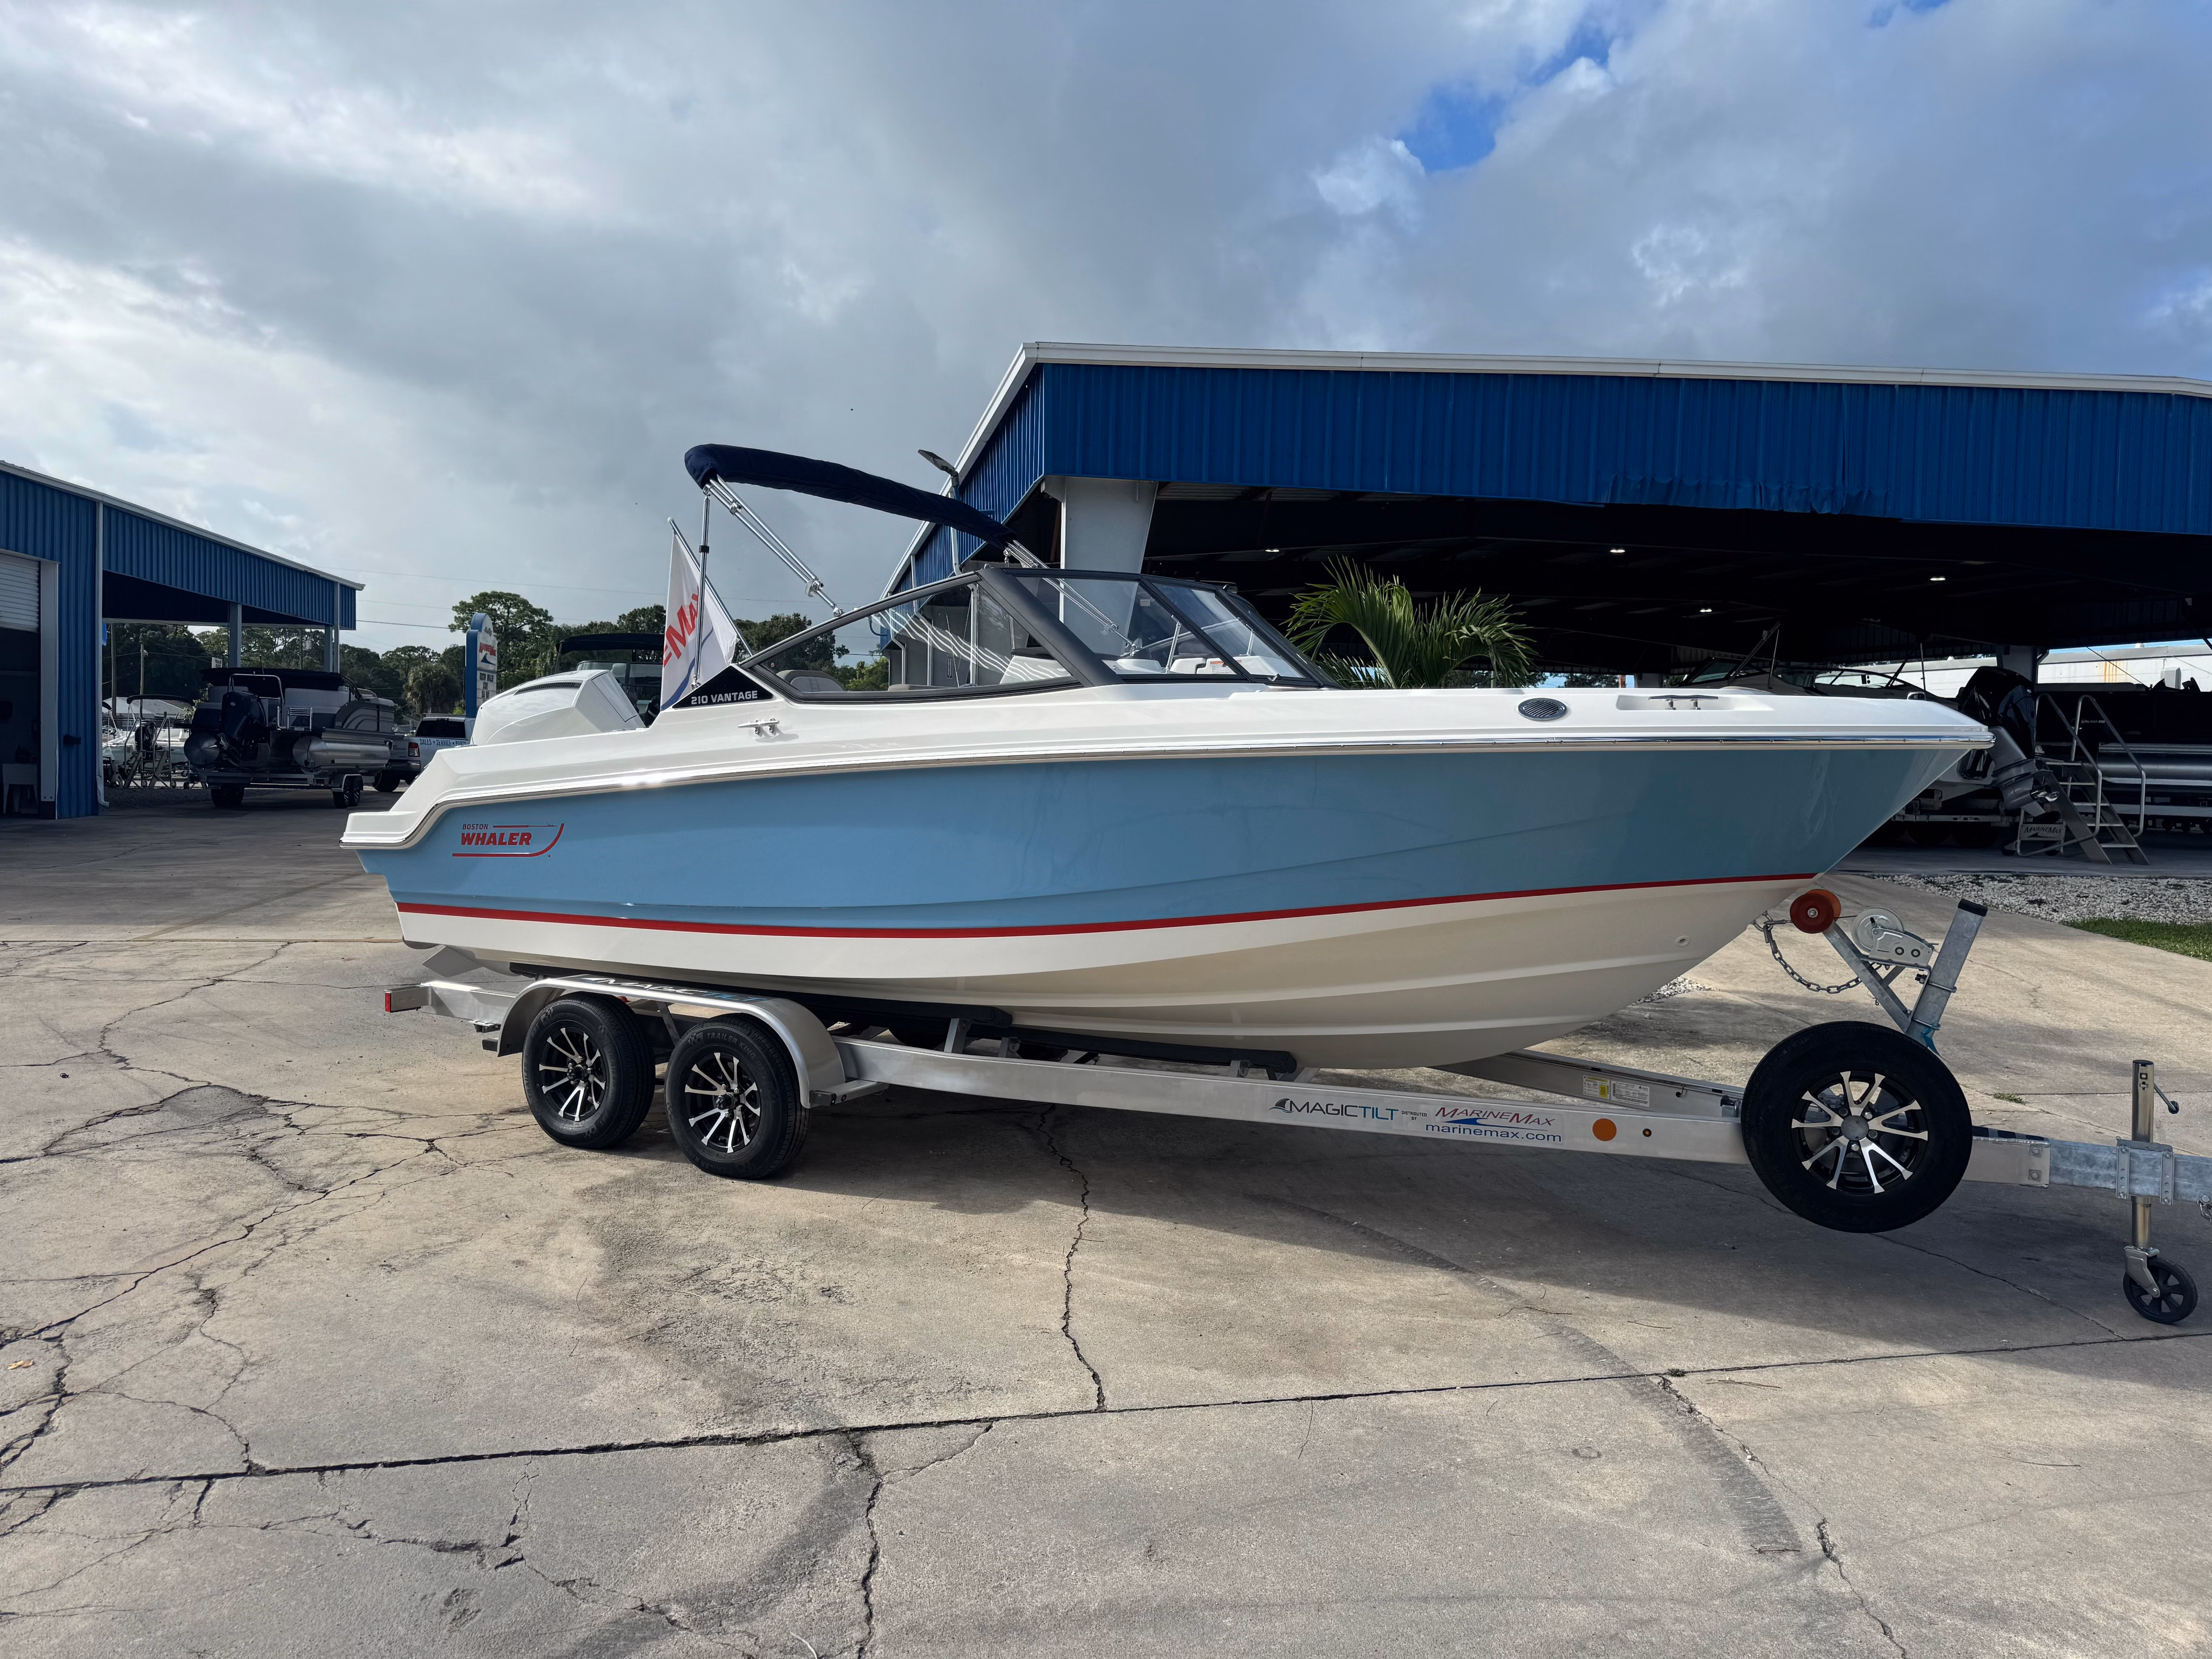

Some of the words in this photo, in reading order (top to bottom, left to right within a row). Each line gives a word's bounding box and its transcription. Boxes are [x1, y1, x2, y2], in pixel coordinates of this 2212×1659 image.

[691, 695, 708, 704] 210
[711, 691, 757, 703] VANTAGE
[461, 832, 532, 846] WHALER
[707, 1032, 738, 1045] TRAILER
[739, 1041, 756, 1059] KING
[1289, 1100, 1399, 1120] MAGICTILT
[1435, 1107, 1555, 1126] MARINEMAX
[1426, 1124, 1562, 1142] marinemax.com
